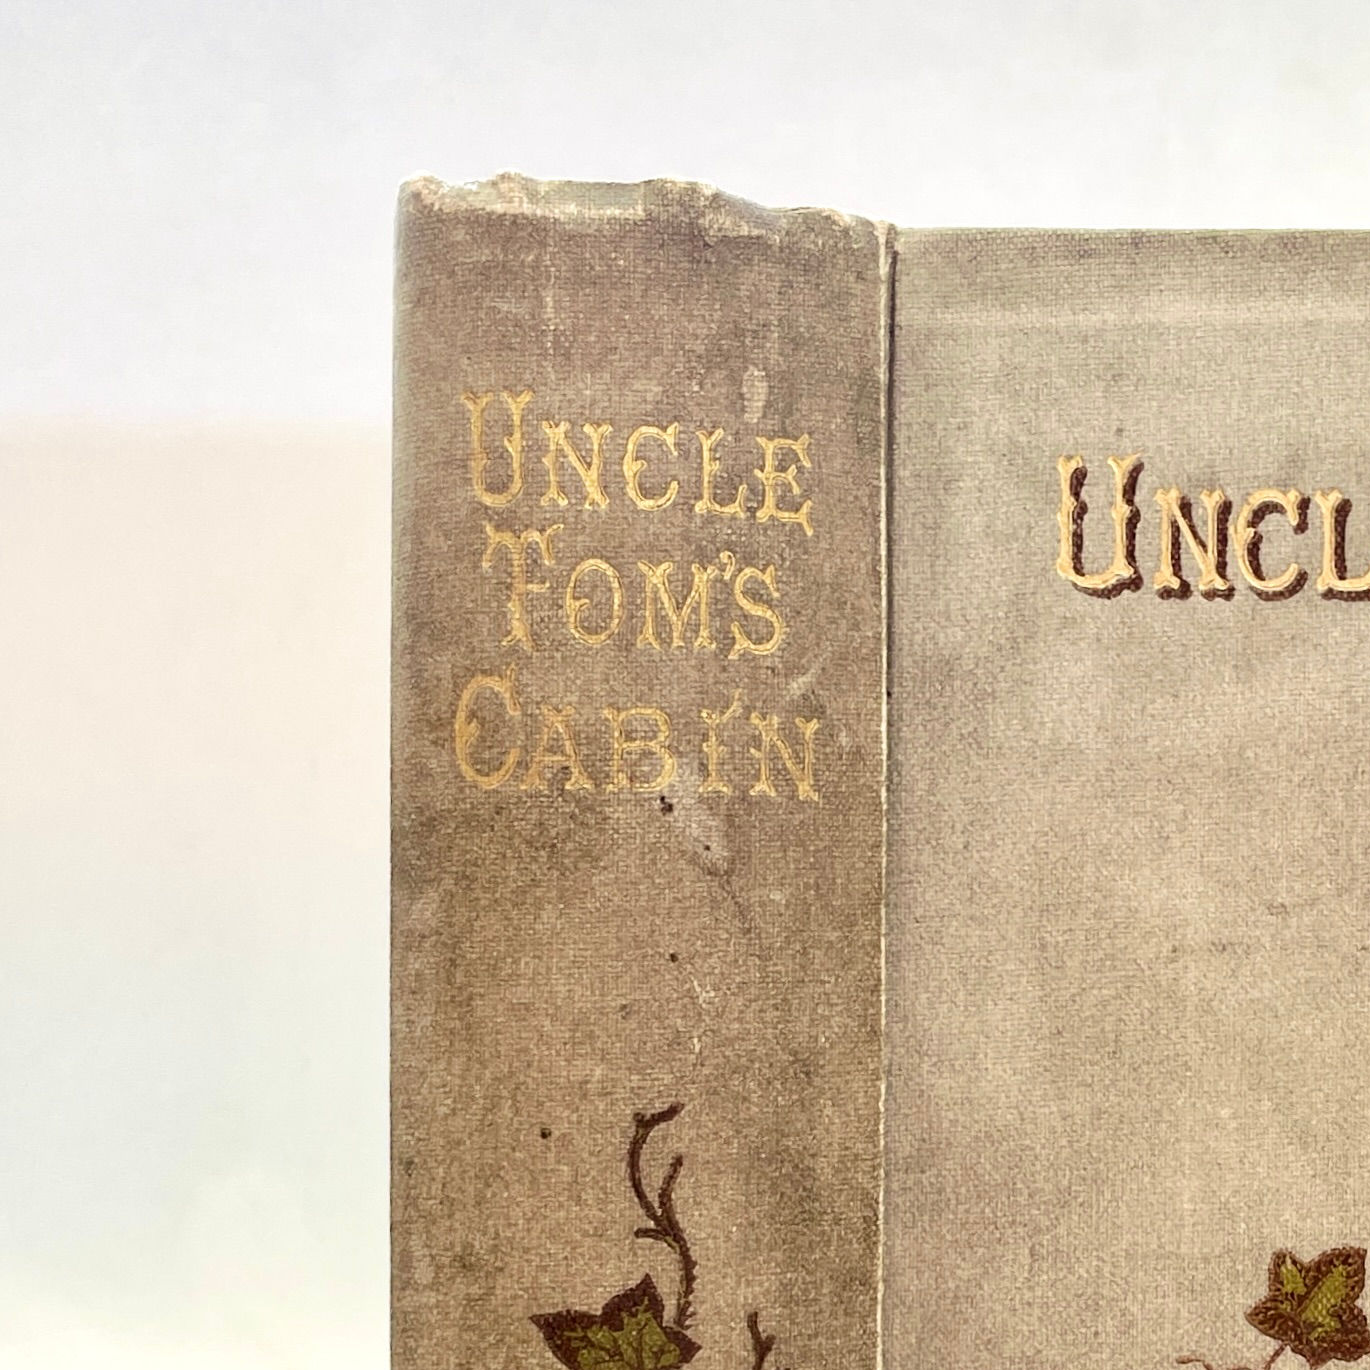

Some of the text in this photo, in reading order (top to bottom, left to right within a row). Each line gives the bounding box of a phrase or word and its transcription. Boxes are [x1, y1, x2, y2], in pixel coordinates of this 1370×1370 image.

[462, 389, 814, 537] UNCLE
[482, 521, 786, 660] TOM'S
[454, 662, 821, 801] CABIN
